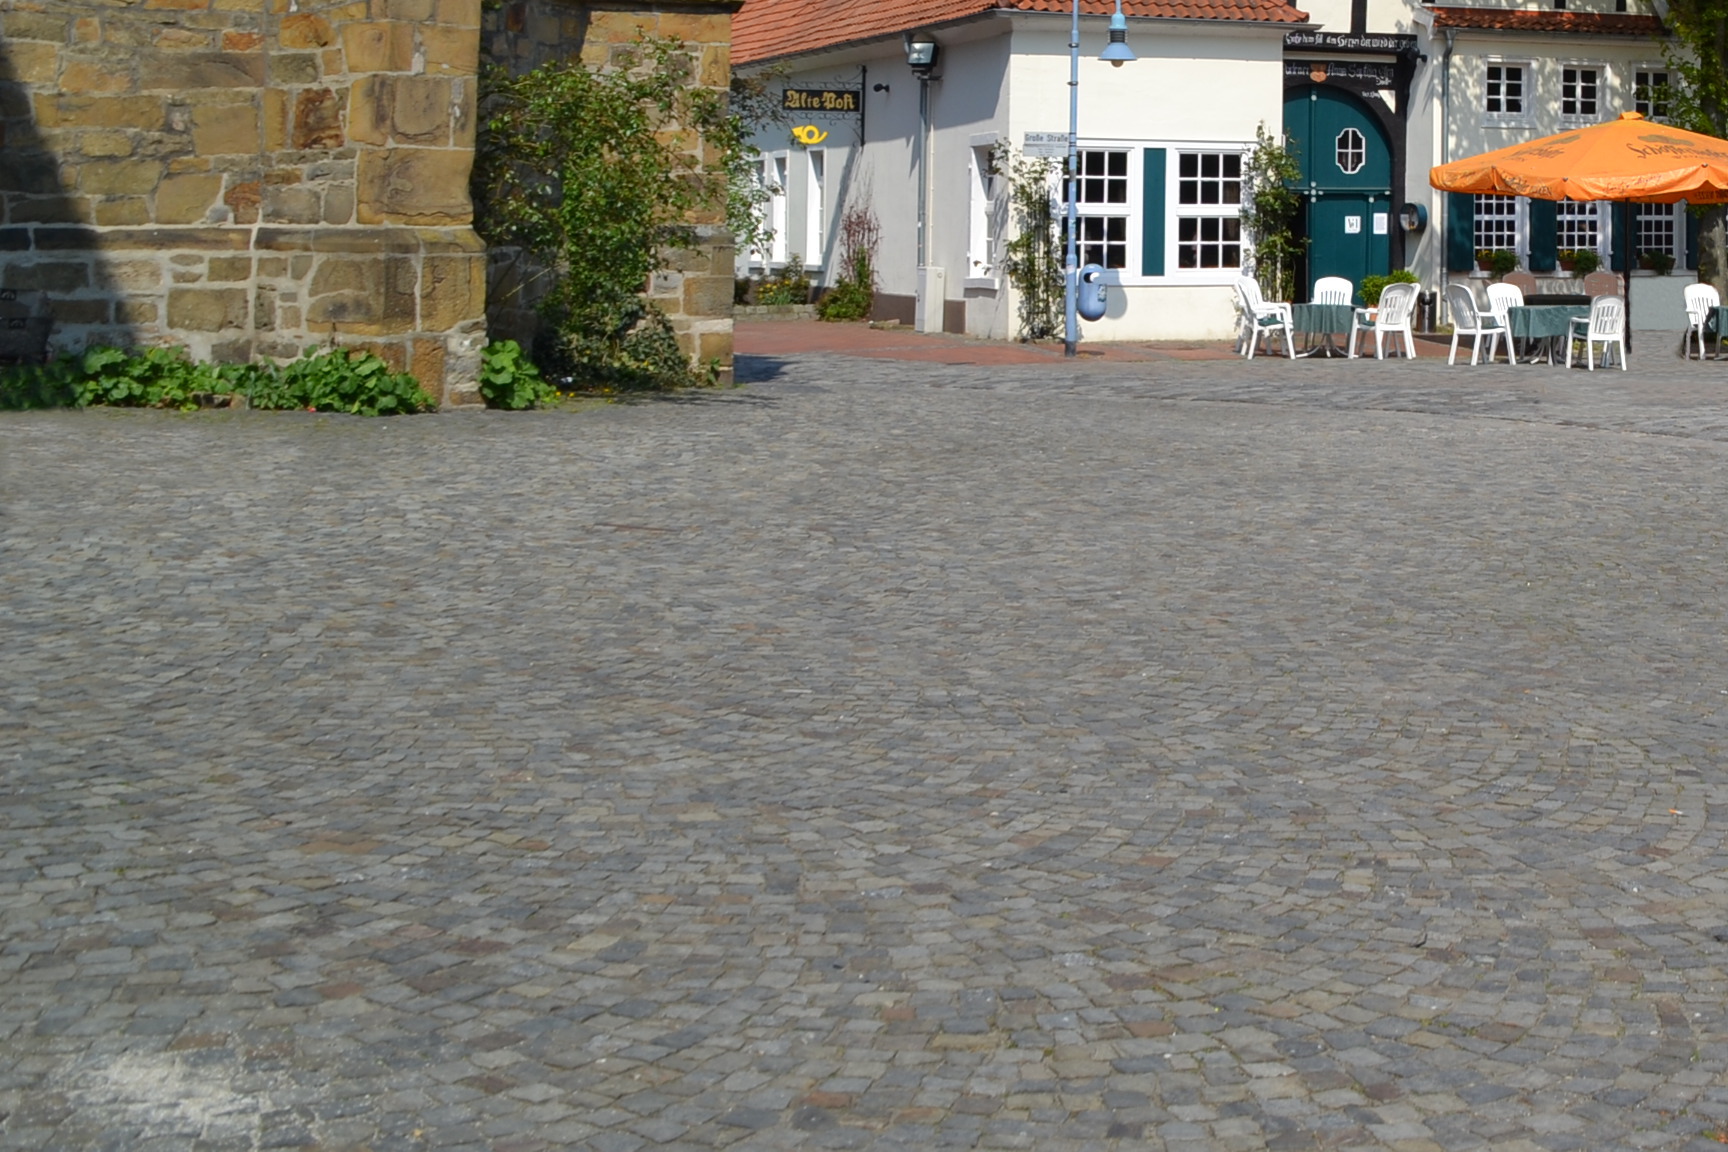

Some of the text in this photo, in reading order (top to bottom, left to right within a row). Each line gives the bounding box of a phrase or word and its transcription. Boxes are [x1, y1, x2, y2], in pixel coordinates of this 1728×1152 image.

[784, 90, 856, 110] Alte Post
[1025, 133, 1068, 143] Große Straße
